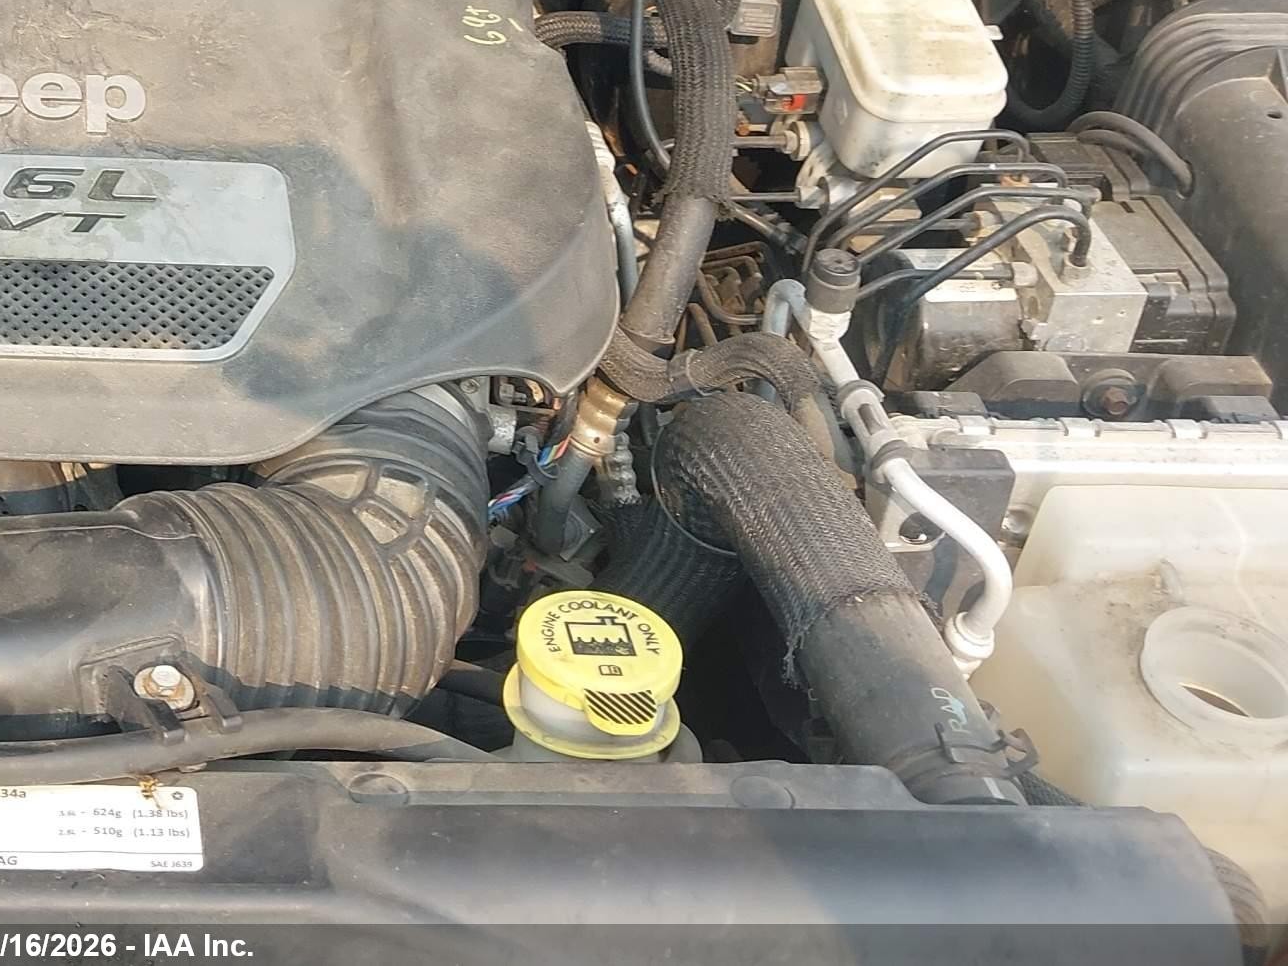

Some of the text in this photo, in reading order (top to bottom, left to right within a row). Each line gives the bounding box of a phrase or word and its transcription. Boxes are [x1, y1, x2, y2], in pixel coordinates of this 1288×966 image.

[543, 600, 660, 656] ENGINE COOLANT ONLY
[93, 808, 123, 819] 624g
[132, 808, 163, 819] (1.38
[167, 809, 189, 819] lbs)
[93, 827, 123, 838] 510g
[133, 827, 165, 838] (1.13
[168, 828, 191, 838] lbs)
[171, 860, 193, 868] J639
